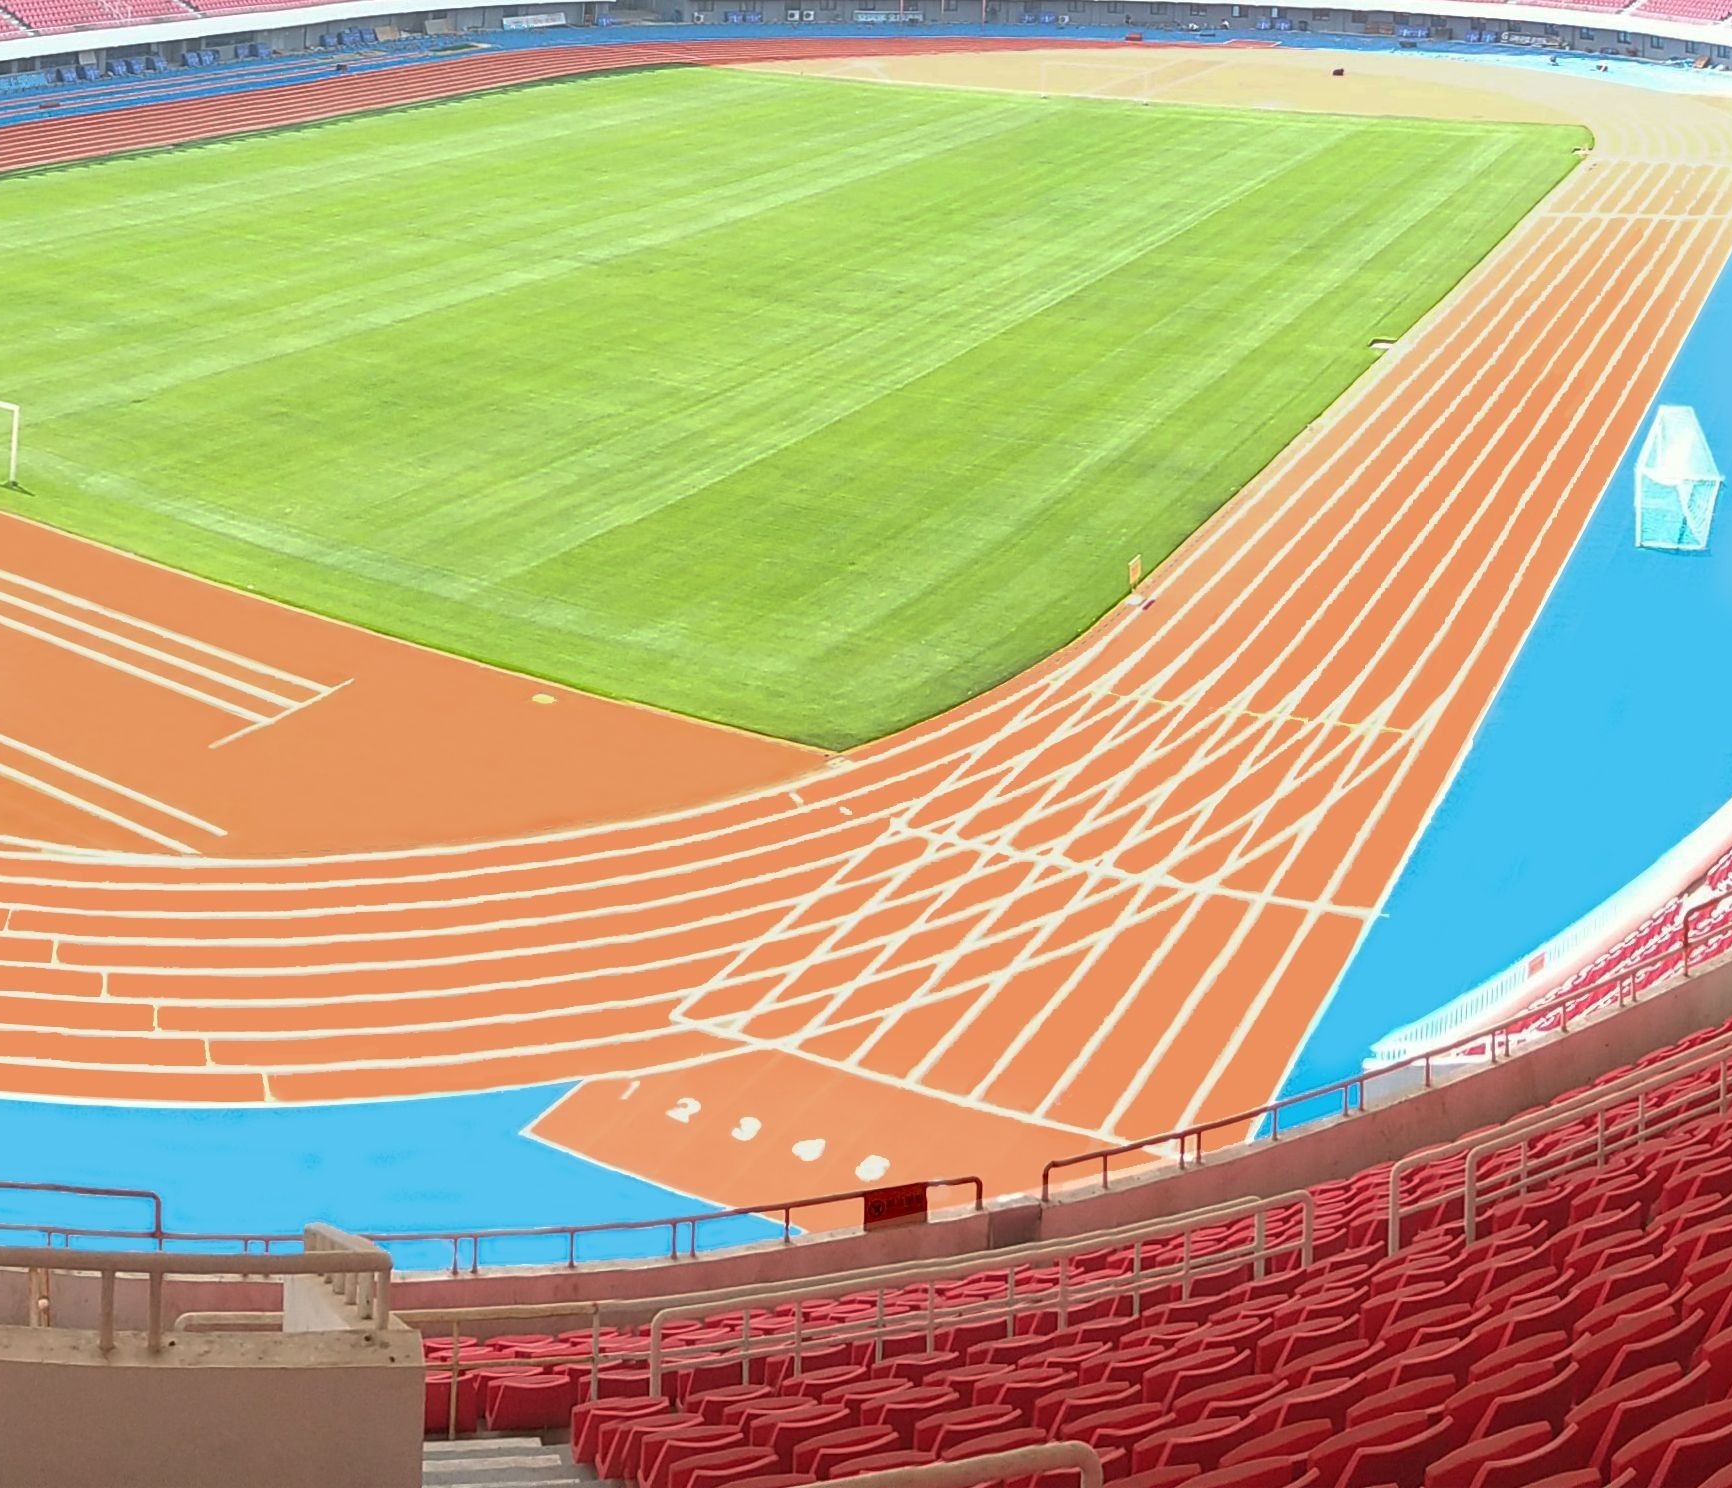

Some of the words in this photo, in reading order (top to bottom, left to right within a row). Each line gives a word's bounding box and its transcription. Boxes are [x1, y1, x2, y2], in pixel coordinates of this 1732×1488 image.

[619, 1080, 640, 1100] 1
[665, 1097, 702, 1123] 2
[731, 1116, 762, 1141] 3
